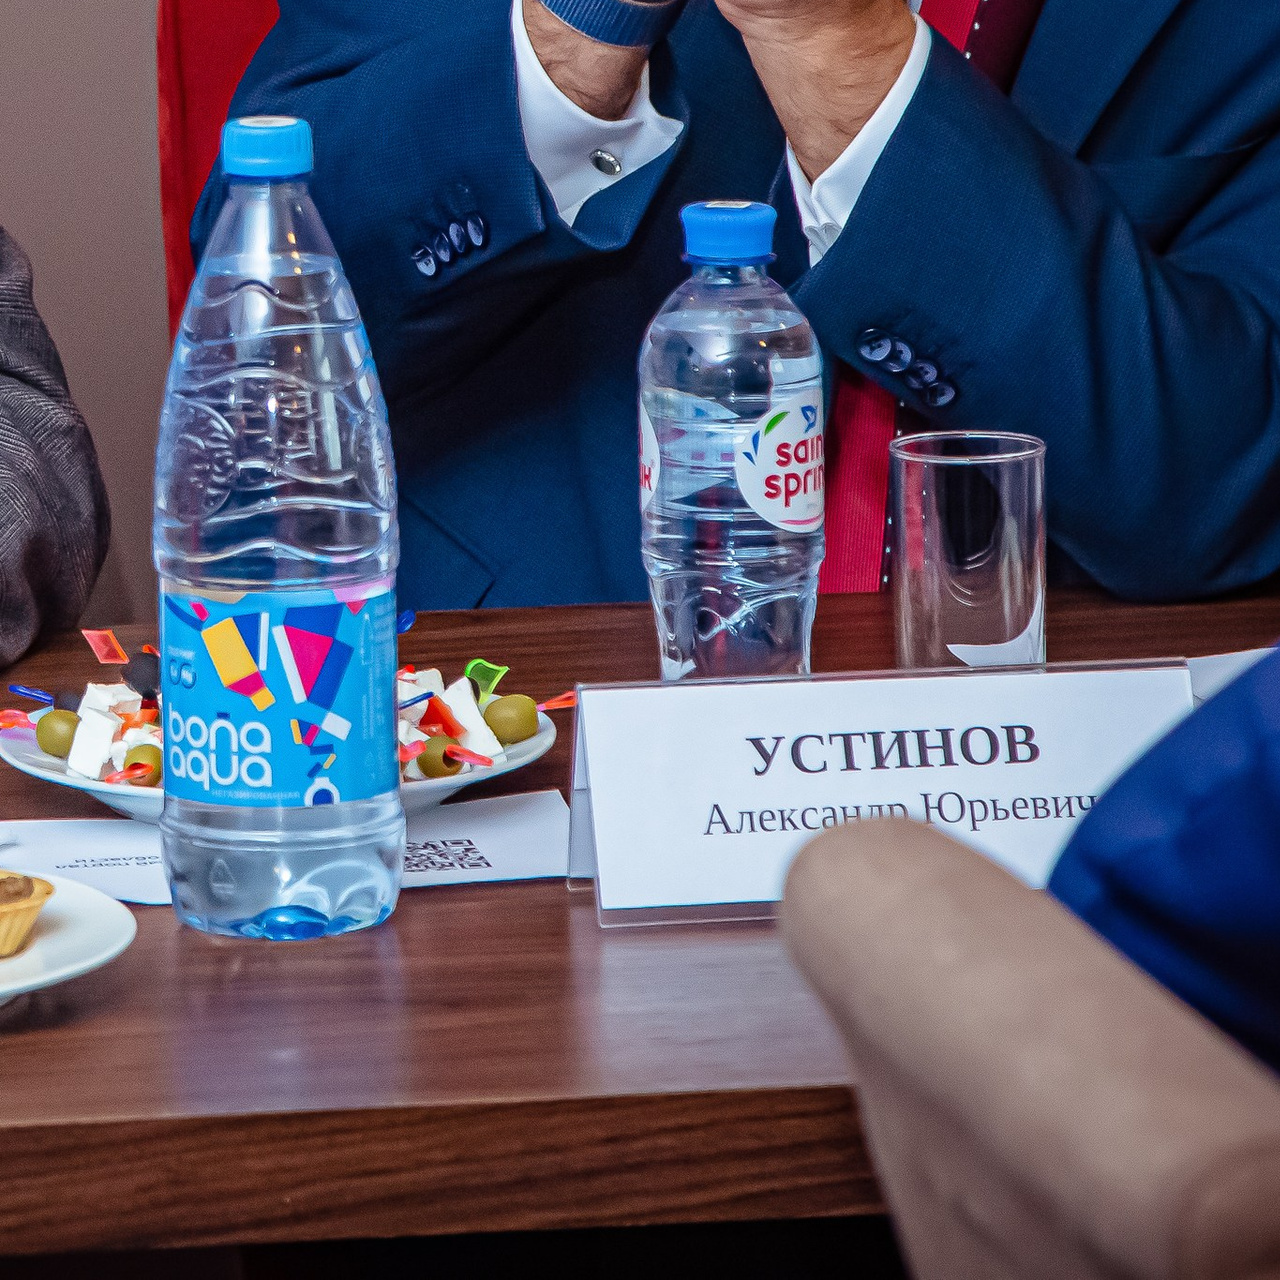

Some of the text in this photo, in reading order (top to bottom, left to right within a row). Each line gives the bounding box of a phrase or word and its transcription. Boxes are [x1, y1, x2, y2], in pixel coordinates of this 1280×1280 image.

[170, 745, 273, 791] aqua
[745, 724, 1041, 776] УСТИНОВ
[919, 791, 1098, 832] Юрьевич
